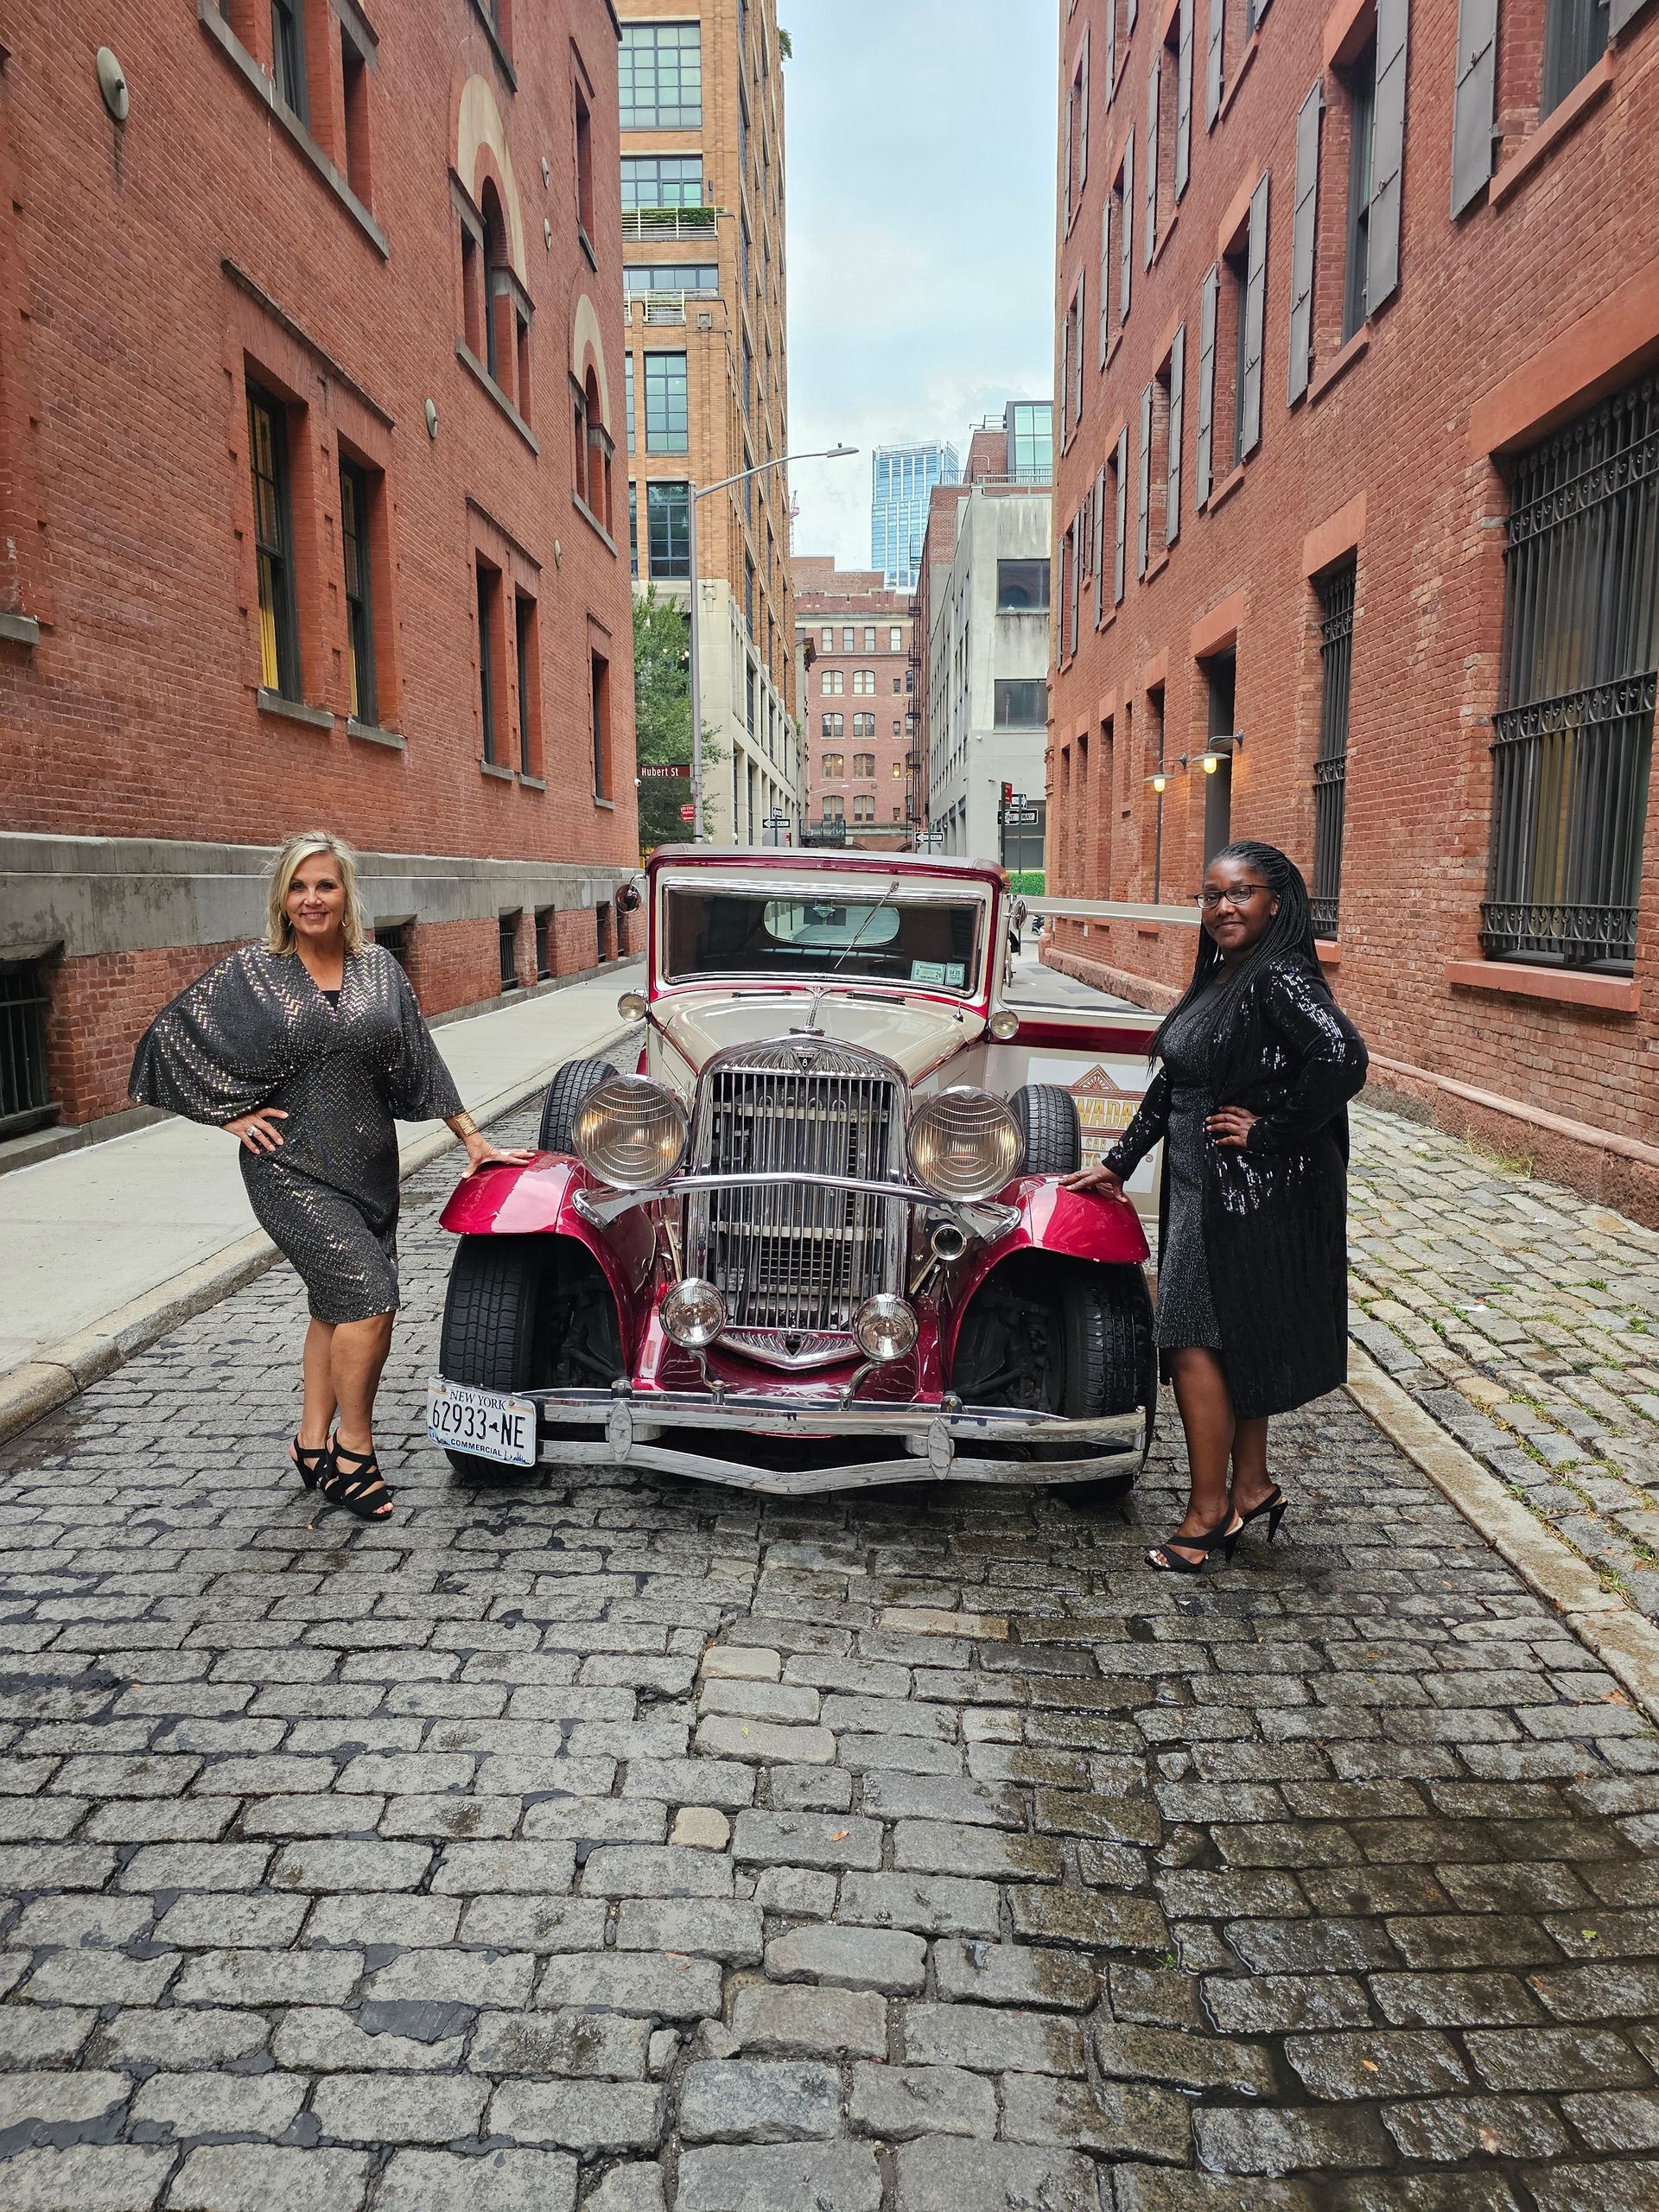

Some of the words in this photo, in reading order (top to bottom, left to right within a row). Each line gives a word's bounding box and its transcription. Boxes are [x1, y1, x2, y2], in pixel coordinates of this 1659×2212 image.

[641, 766, 669, 777] Hubert
[671, 767, 679, 777] St
[802, 1058, 808, 1067] 8
[1085, 1137, 1107, 1150] CAR
[449, 1389, 476, 1404] NEW
[477, 1395, 506, 1411] YORK
[432, 1398, 487, 1440] 62933
[500, 1413, 525, 1449] NE
[450, 1438, 502, 1457] COMMERCIAL
